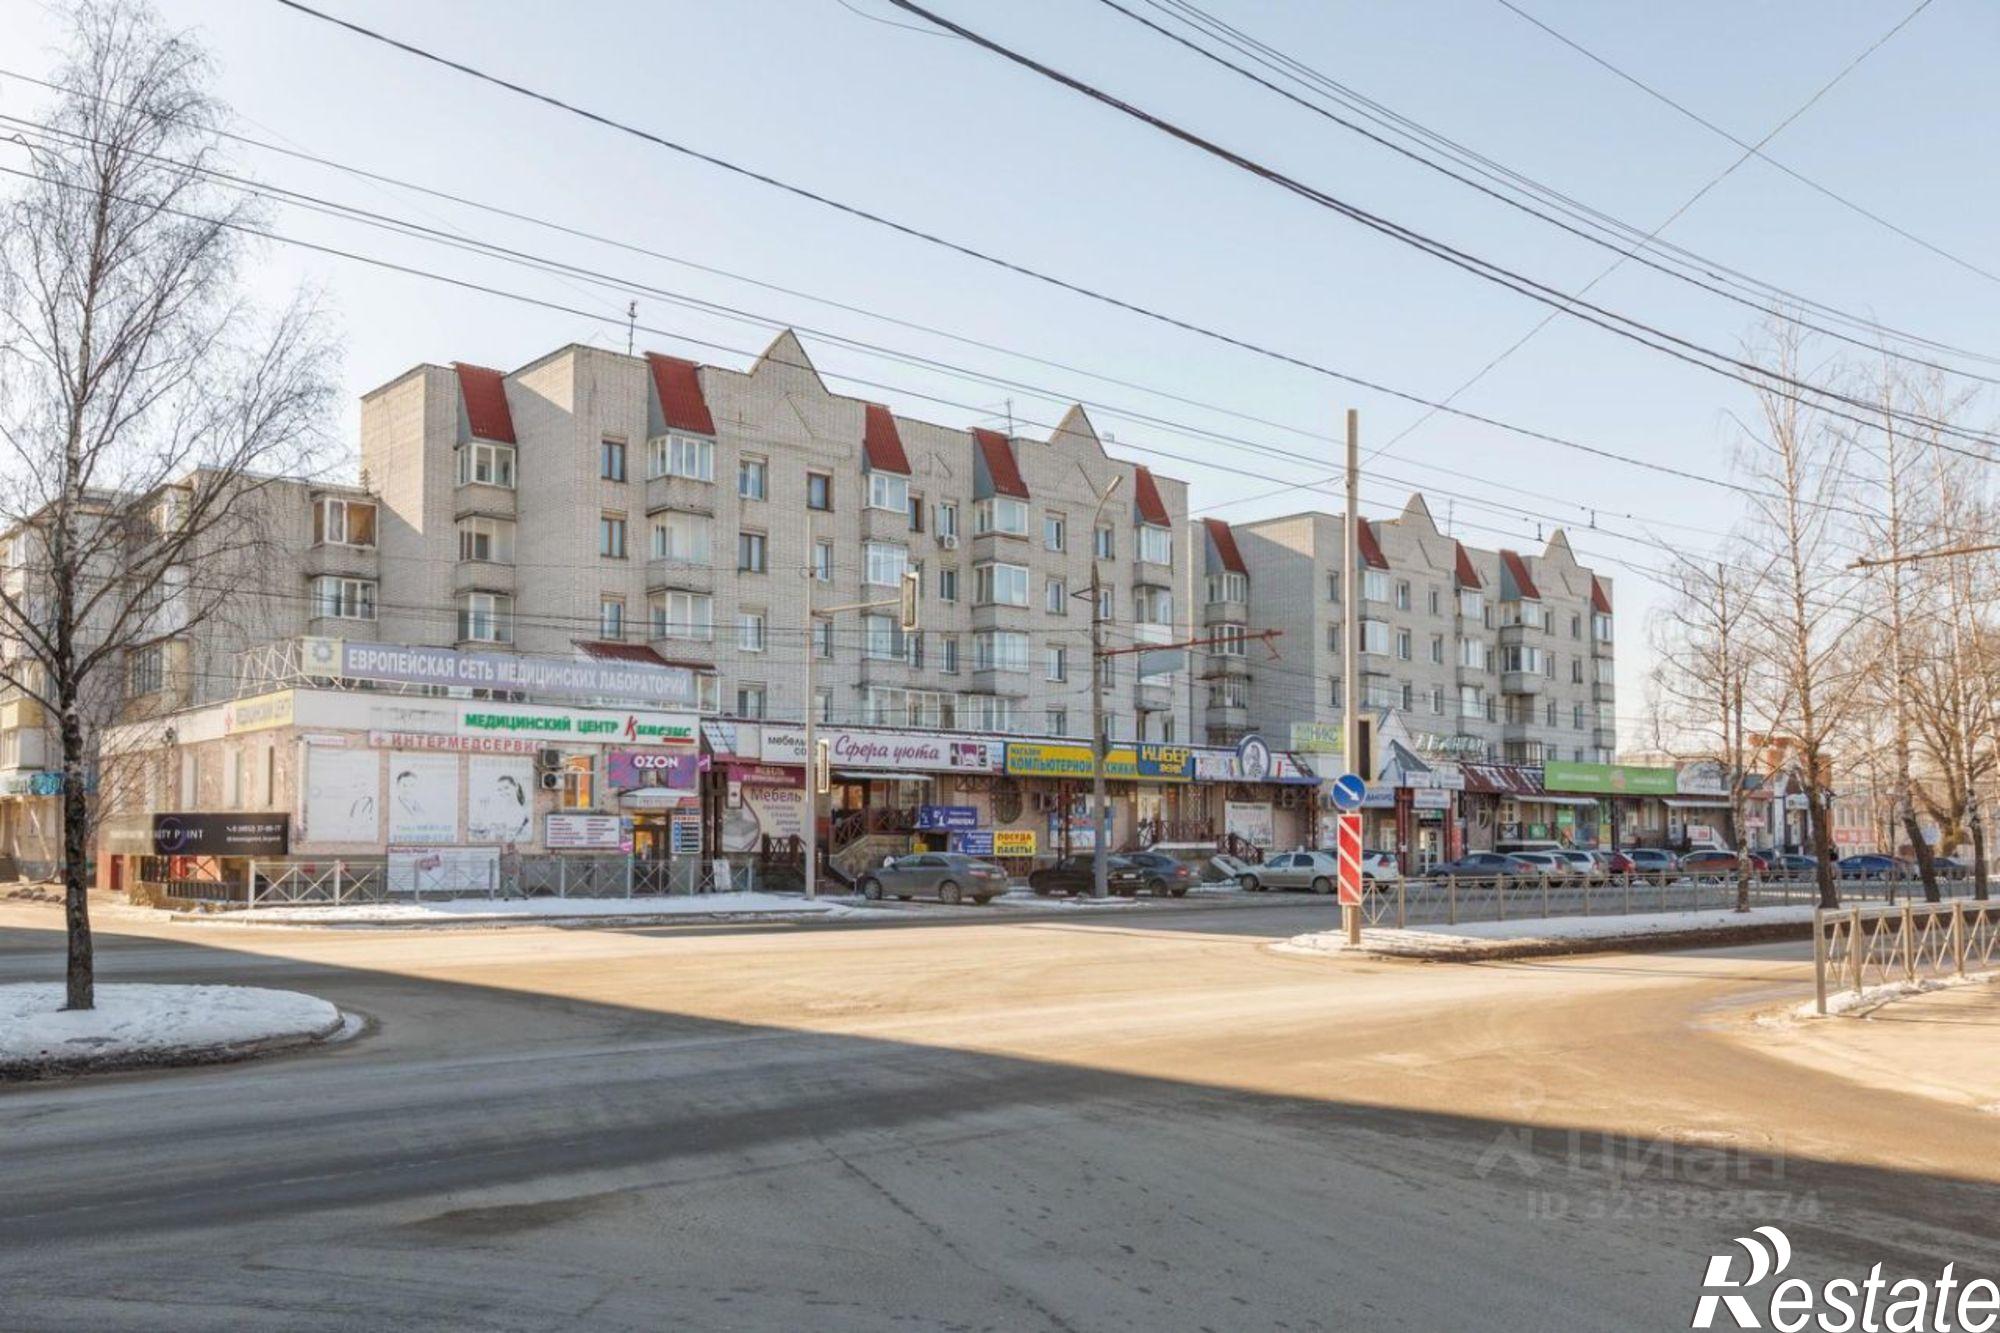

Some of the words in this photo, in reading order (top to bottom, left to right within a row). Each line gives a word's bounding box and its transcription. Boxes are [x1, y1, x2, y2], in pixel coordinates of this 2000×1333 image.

[348, 649, 454, 677] ЕВРОПЕЙСКАЯ
[458, 657, 494, 681] СЕТЬ
[497, 662, 598, 689] МЕДИЦИНСКИХ
[599, 670, 688, 695] ЛАБОРАТОРИЙ
[464, 713, 571, 731] МЕДИЦИНСКИЙ
[577, 719, 619, 734] ЦЕНТР
[392, 733, 546, 753] ИНТЕРМЕДСЕРВИС
[836, 735, 889, 762] Сфера
[893, 746, 940, 763] уюта
[633, 755, 680, 768] OZON
[751, 787, 801, 802] Мебель
[997, 832, 1032, 841] ПОСУДА
[997, 846, 1032, 854] ПАКЕТЫ
